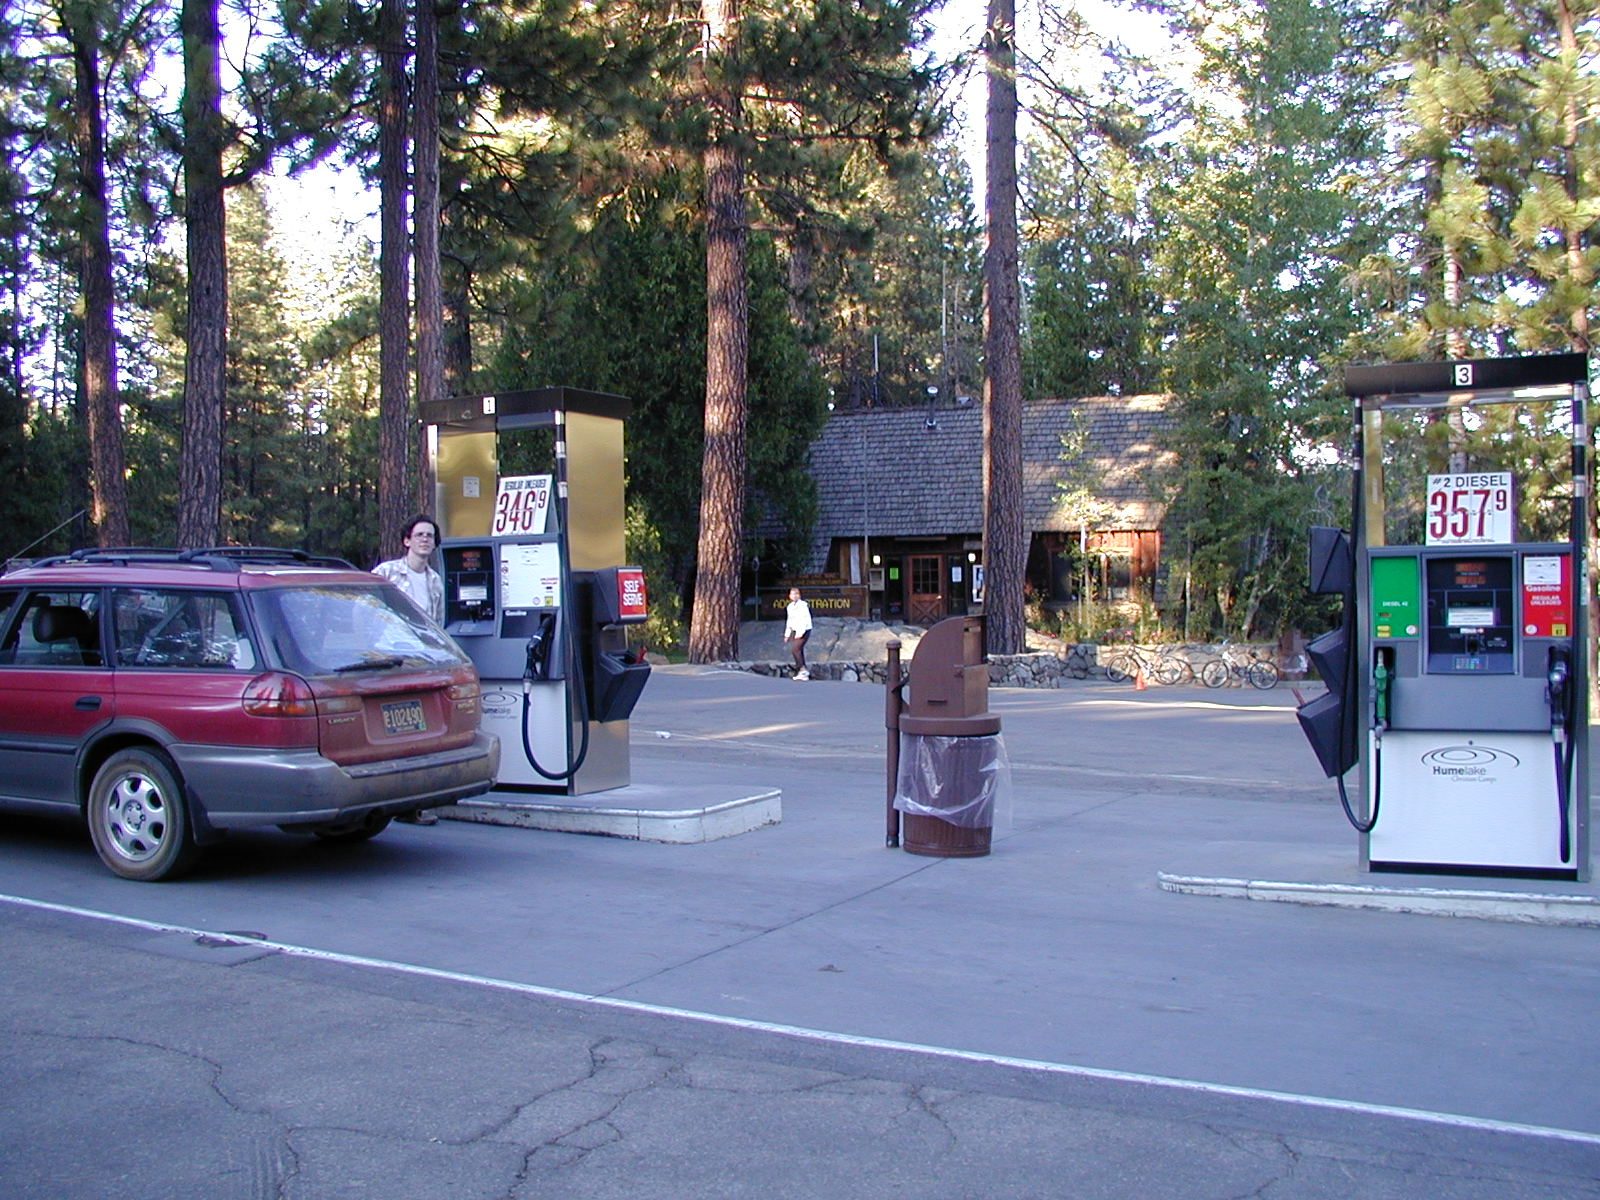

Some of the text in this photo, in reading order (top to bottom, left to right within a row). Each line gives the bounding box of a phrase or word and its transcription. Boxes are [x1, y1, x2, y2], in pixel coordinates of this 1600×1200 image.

[1458, 367, 1470, 383] 3
[1455, 475, 1508, 488] DIESEL
[624, 580, 640, 592] SELF
[623, 593, 643, 606] SERVE
